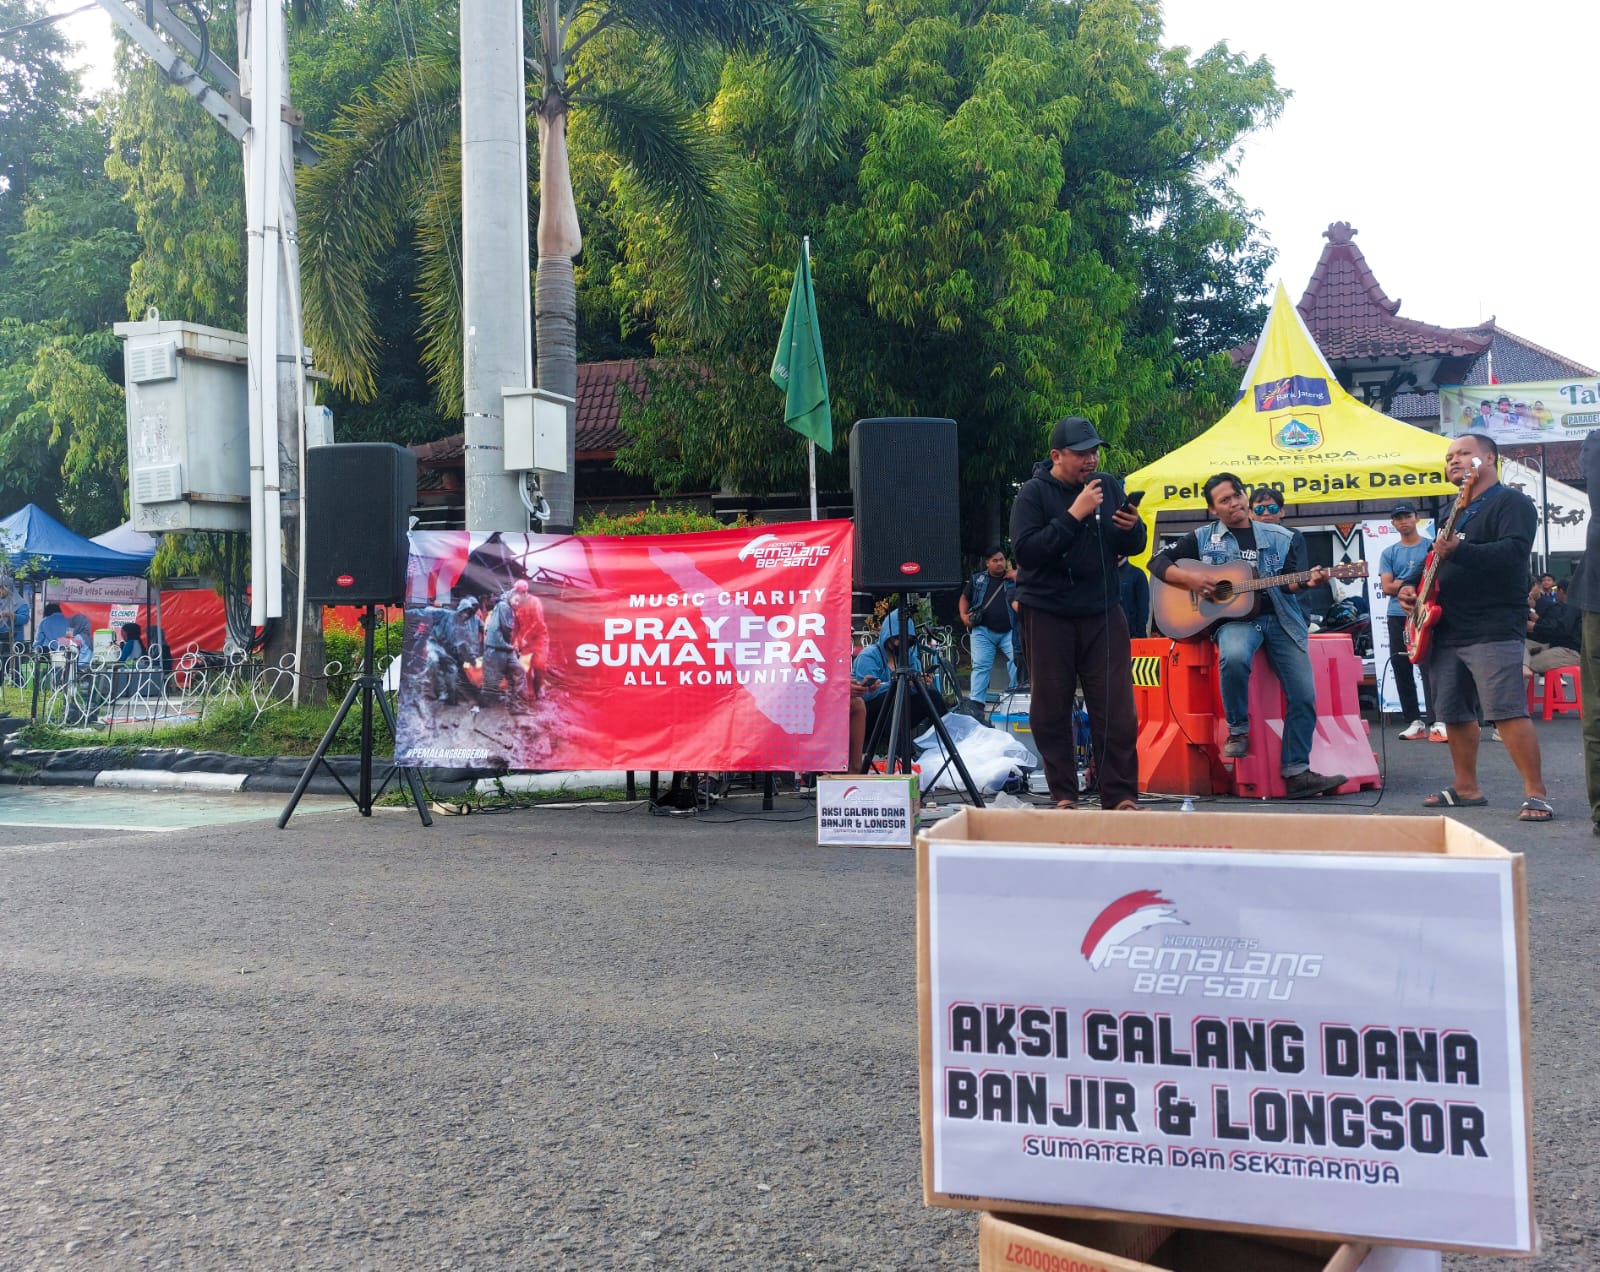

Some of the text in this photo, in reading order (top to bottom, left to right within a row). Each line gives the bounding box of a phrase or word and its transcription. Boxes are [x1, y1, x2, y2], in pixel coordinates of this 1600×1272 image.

[1276, 390, 1325, 401] Bank Jateng
[1246, 450, 1359, 462] BAPENDA
[1293, 473, 1361, 494] Pajak
[629, 588, 826, 608] MUSIC CHARITY
[604, 613, 826, 641] PRAY FOR
[575, 638, 826, 667] SUMATERA
[623, 667, 827, 686] ALL KOMUNITAS
[406, 747, 490, 759] #PEMALANGBERGERAK
[821, 807, 905, 817] AKSI GALANG DANA
[821, 818, 906, 829] BANJIR & LONGSOR
[949, 1001, 1481, 1086] AKSI GALANG DANA
[945, 1066, 1489, 1158] BANJIR & LONGSOR
